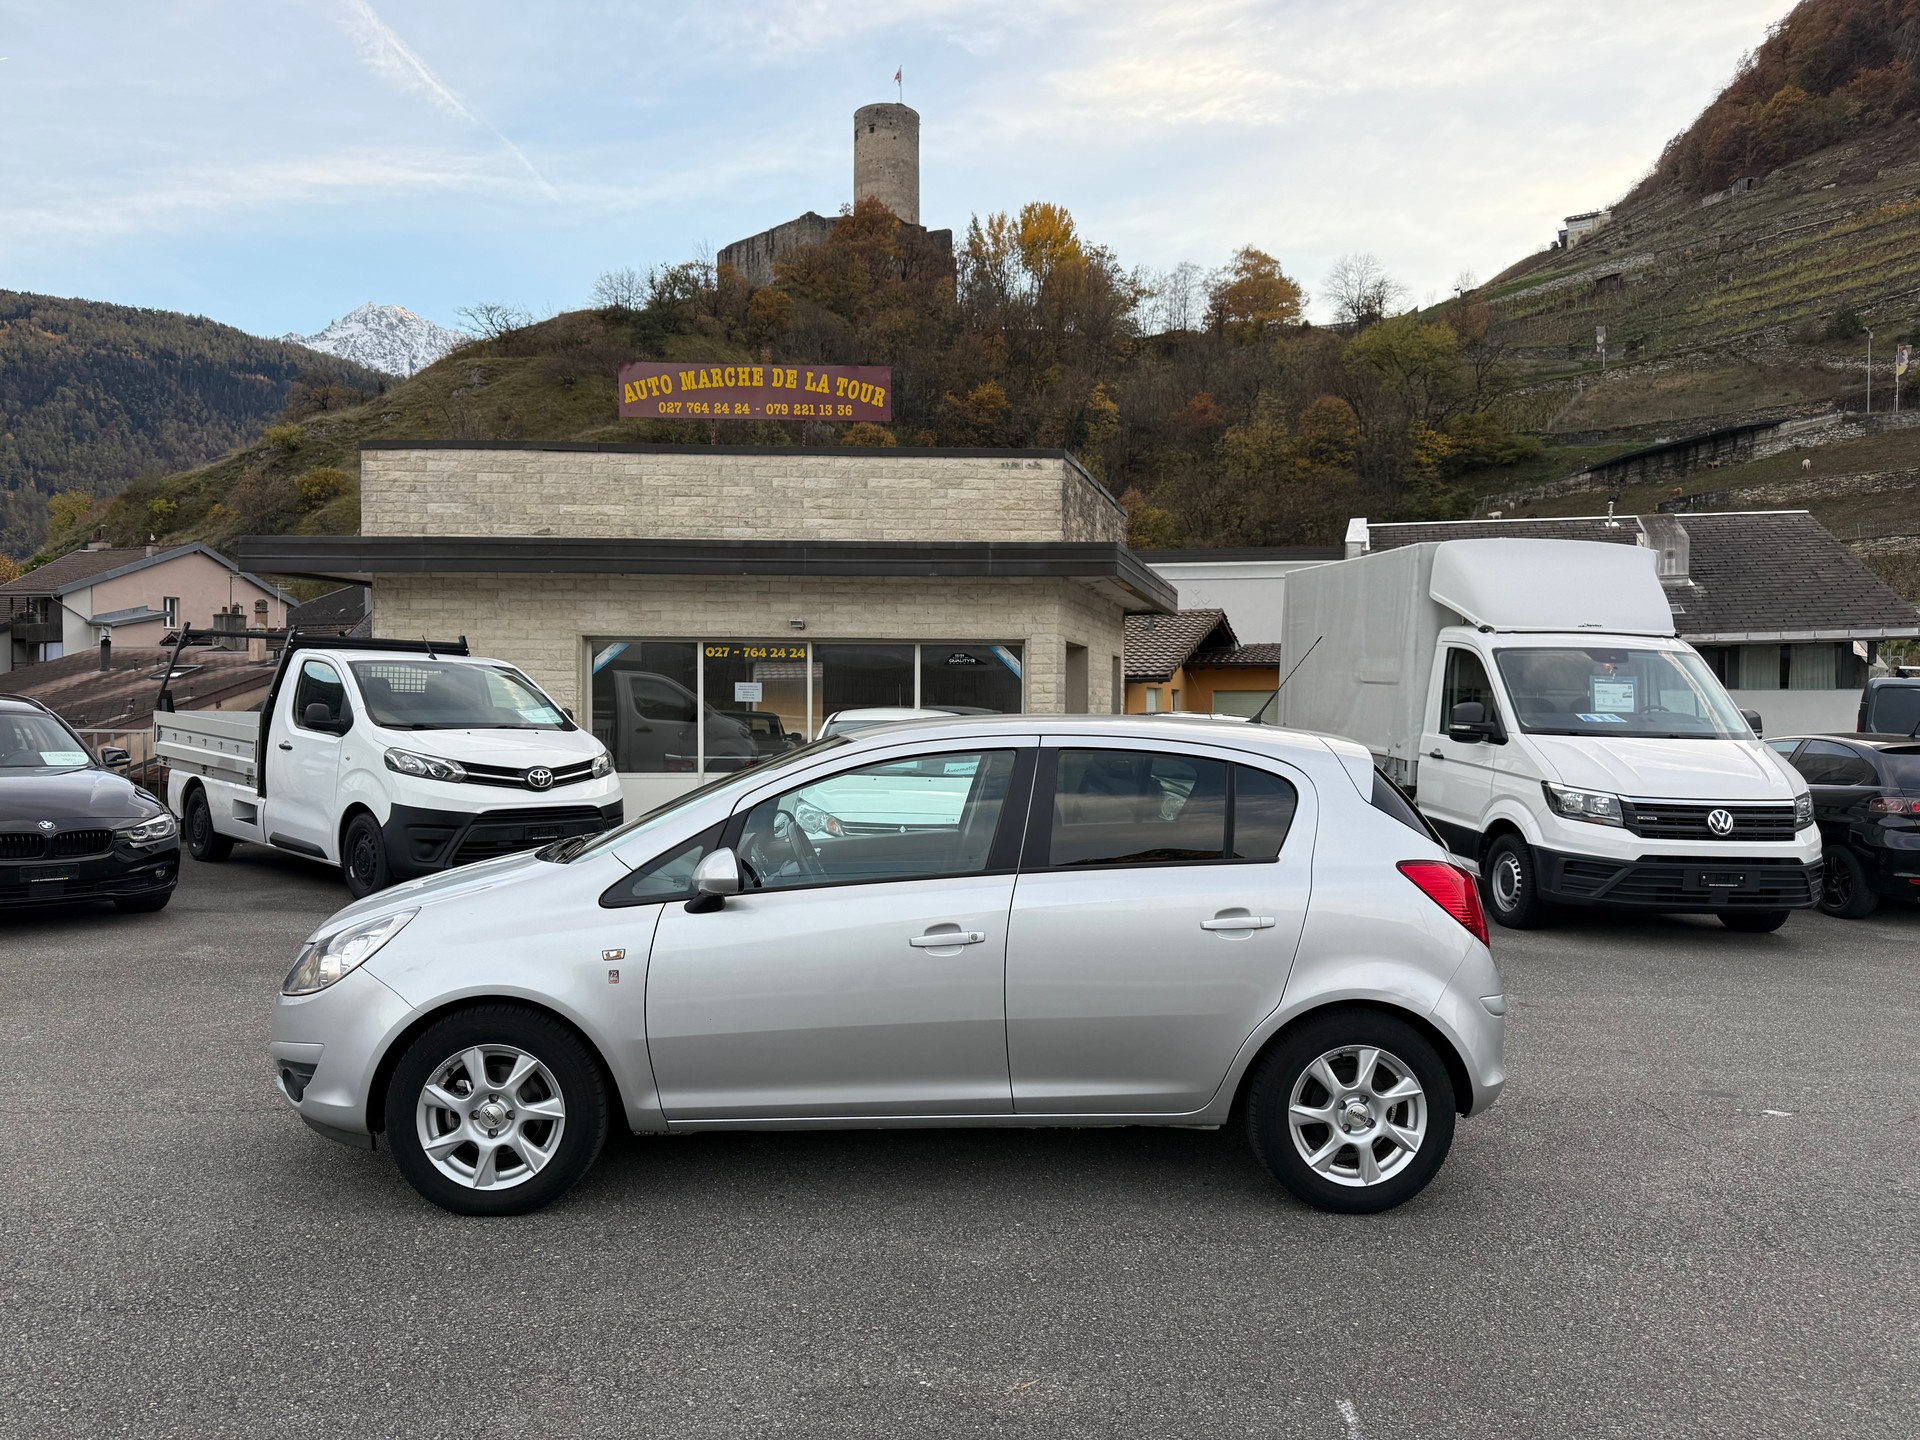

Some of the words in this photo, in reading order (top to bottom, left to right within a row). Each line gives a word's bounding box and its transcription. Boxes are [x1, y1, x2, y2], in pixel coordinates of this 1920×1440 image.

[624, 374, 673, 404] AUTO
[678, 366, 764, 391] MARCHE
[771, 367, 798, 389] DE
[804, 371, 830, 394] LA
[836, 376, 886, 408] TOUR
[658, 401, 683, 414] 027
[686, 402, 710, 414] 764
[713, 402, 730, 415] 24
[734, 402, 751, 415] 24
[765, 403, 789, 416] 079
[793, 403, 816, 416] 221
[819, 404, 833, 416] 13
[837, 404, 853, 416] 36
[705, 646, 730, 658] 027
[743, 647, 767, 658] 764
[770, 647, 787, 658] 24
[789, 647, 806, 659] 24
